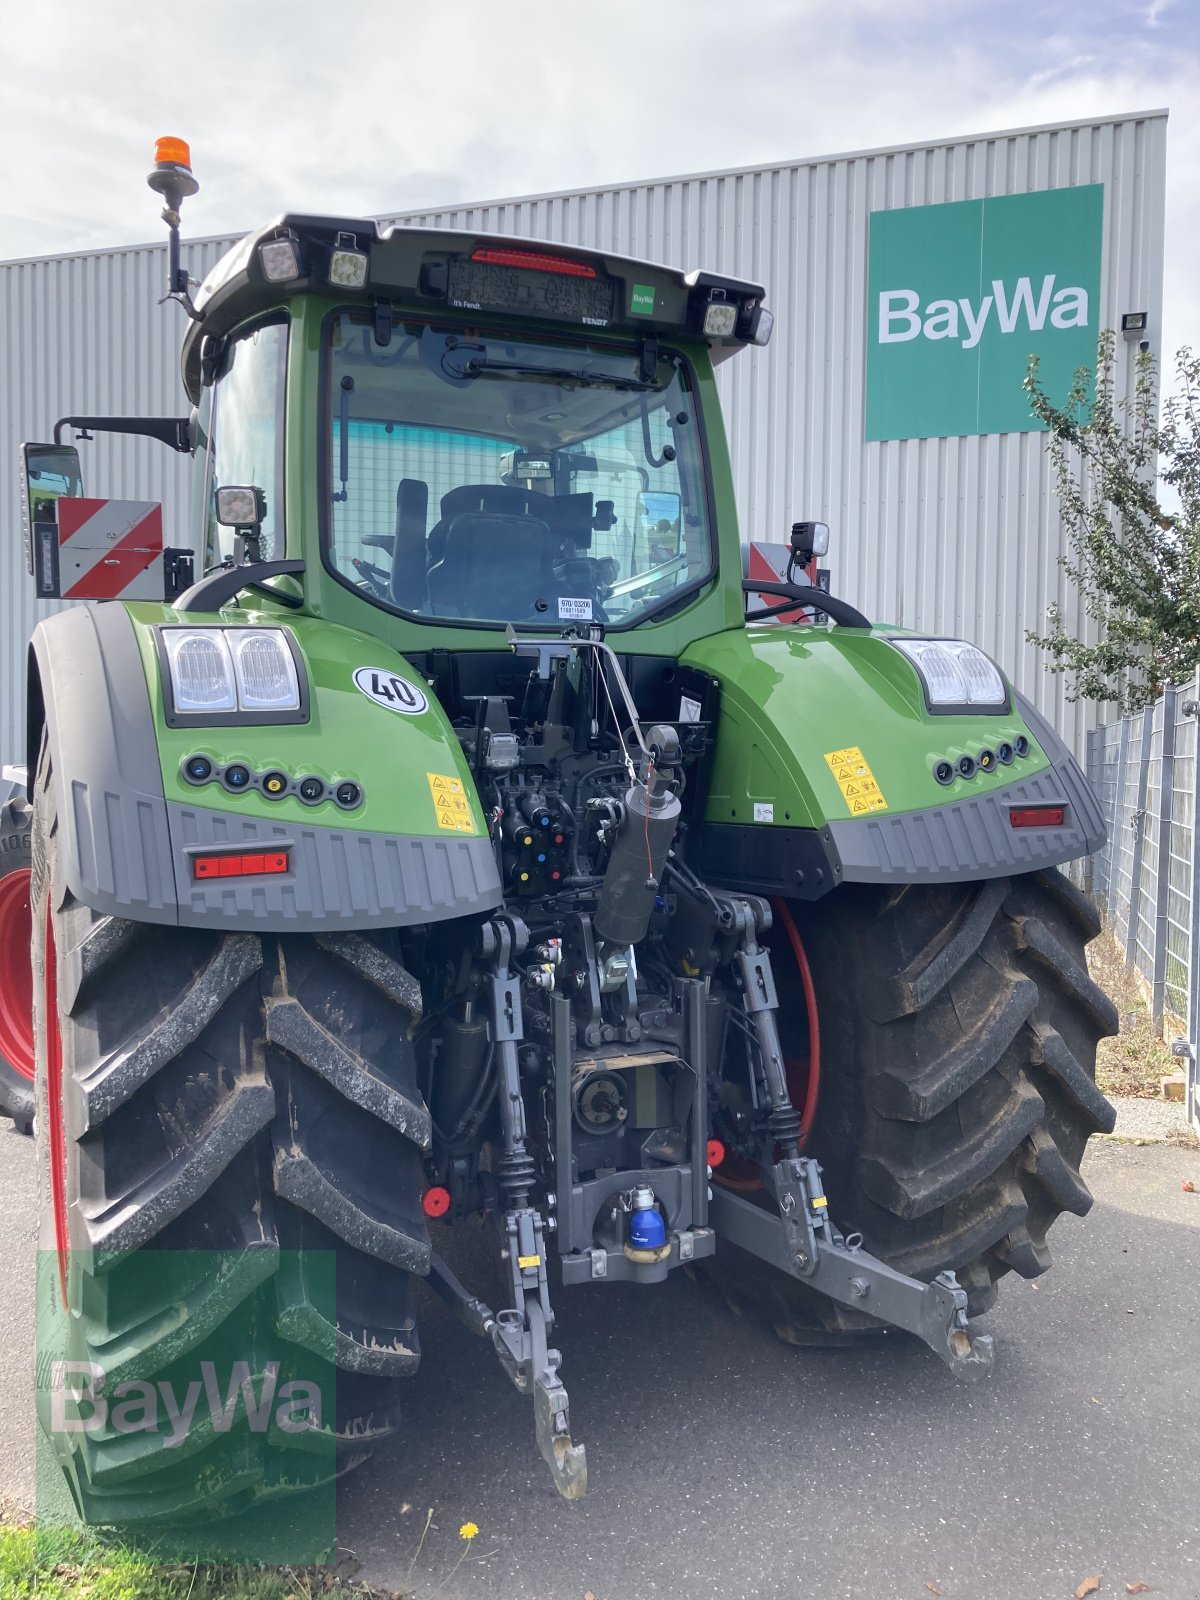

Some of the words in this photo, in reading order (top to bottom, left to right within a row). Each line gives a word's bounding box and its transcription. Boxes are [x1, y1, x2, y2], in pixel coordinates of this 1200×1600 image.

[633, 293, 654, 304] BayWa
[582, 316, 608, 326] FENDT
[878, 274, 1089, 349] BayWa
[371, 673, 417, 707] 40
